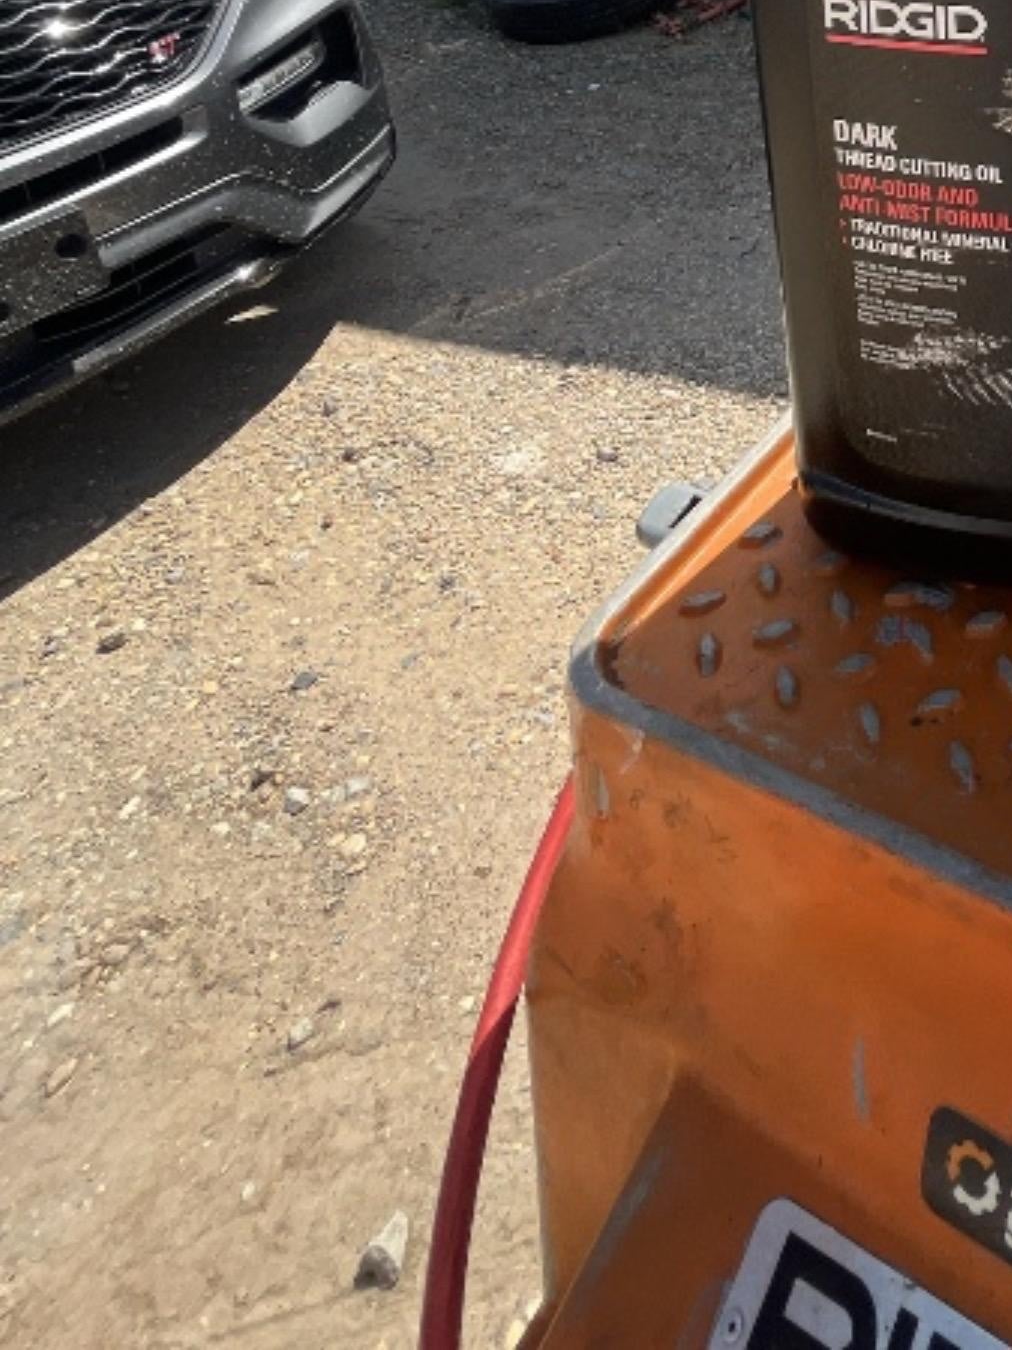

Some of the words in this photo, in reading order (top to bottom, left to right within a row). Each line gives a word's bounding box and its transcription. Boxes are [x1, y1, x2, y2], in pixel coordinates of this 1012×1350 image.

[833, 119, 898, 150] DARK
[899, 158, 972, 180] CUTTING
[975, 164, 1003, 184] OIL
[837, 172, 931, 199] LOW-ODOR
[937, 186, 979, 206] AND
